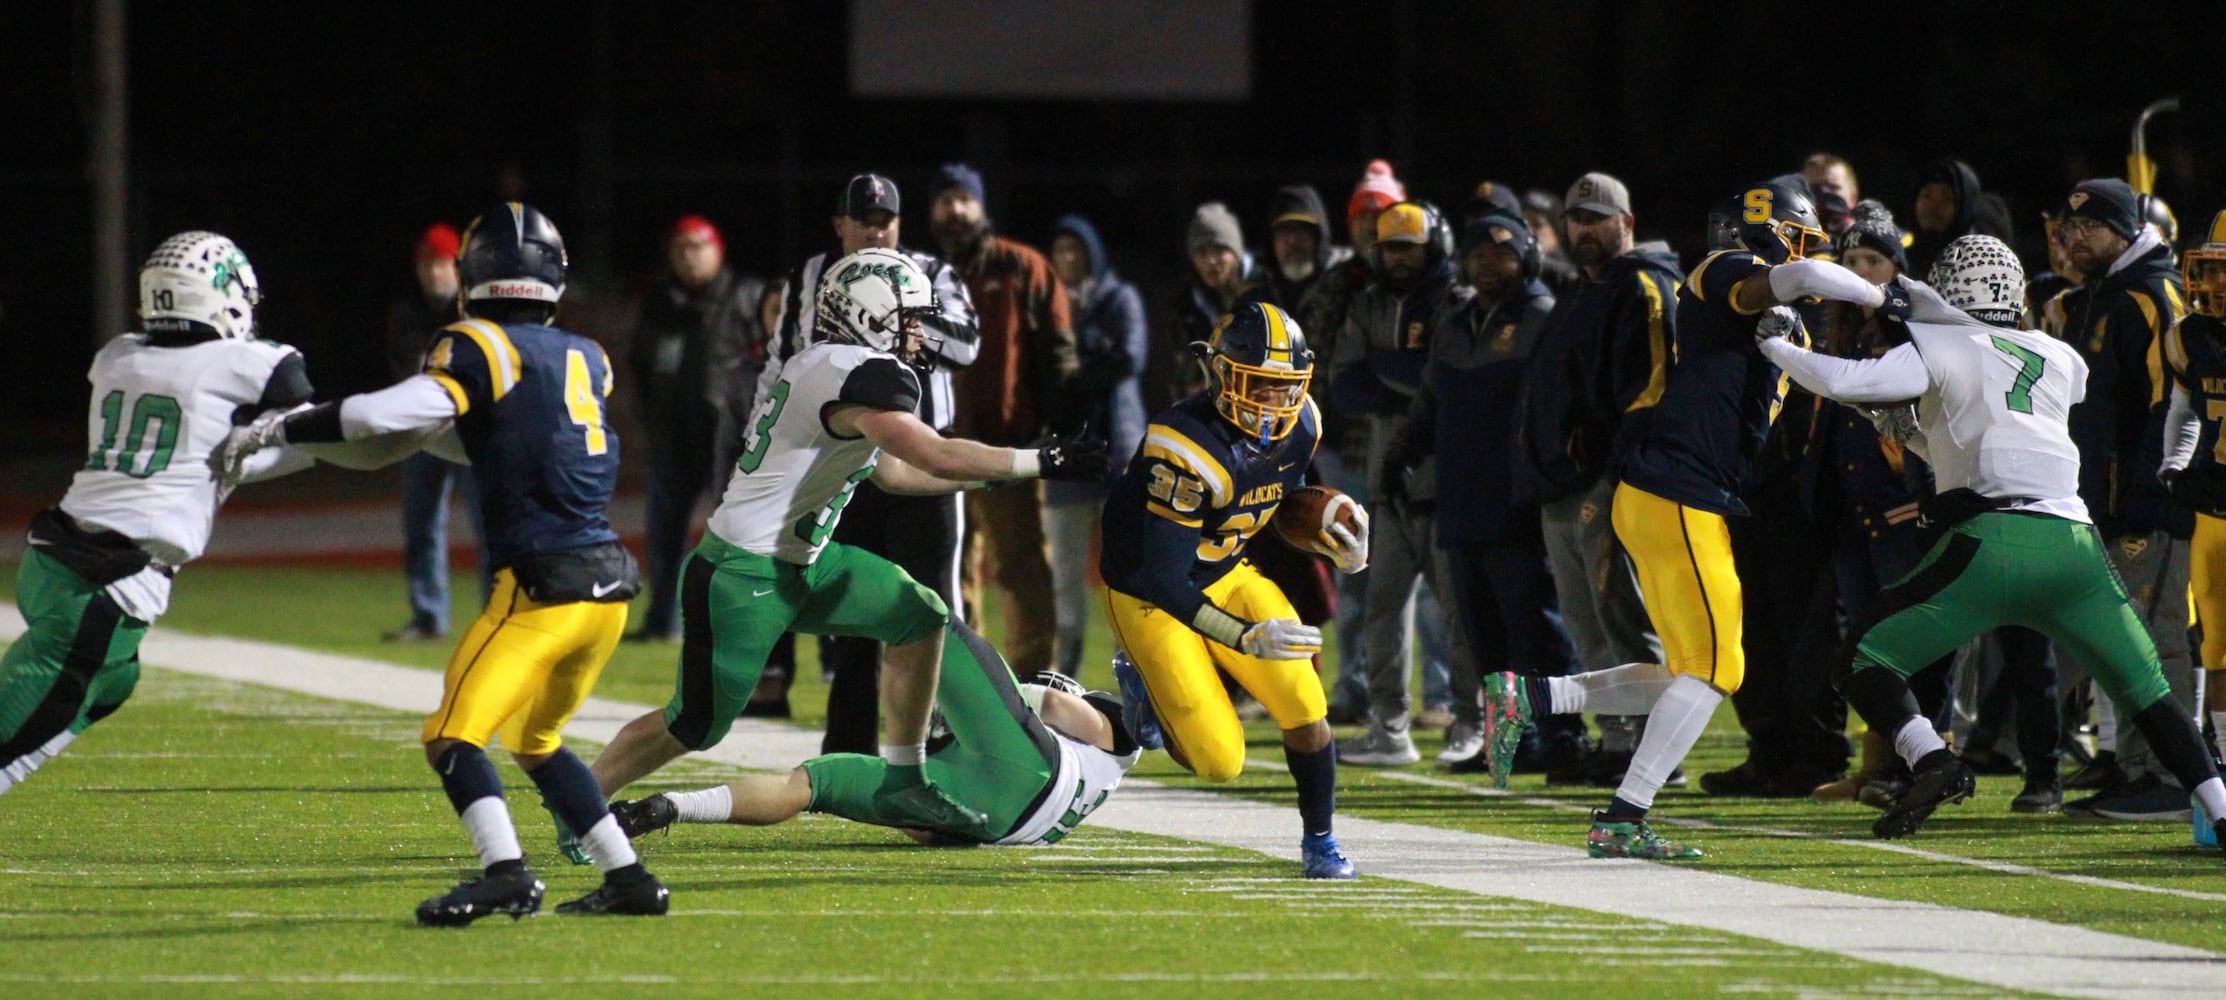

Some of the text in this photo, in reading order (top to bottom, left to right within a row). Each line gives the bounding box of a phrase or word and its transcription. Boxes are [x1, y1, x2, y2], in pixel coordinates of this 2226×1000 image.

[1743, 188, 1773, 225] S
[152, 289, 174, 311] 10
[489, 285, 543, 297] Riddell
[1989, 283, 2001, 302] 7
[1991, 334, 2047, 415] 7
[564, 349, 608, 456] 4
[85, 389, 182, 478] 10
[1147, 463, 1204, 512] 35
[1238, 482, 1283, 507] WILDCATS
